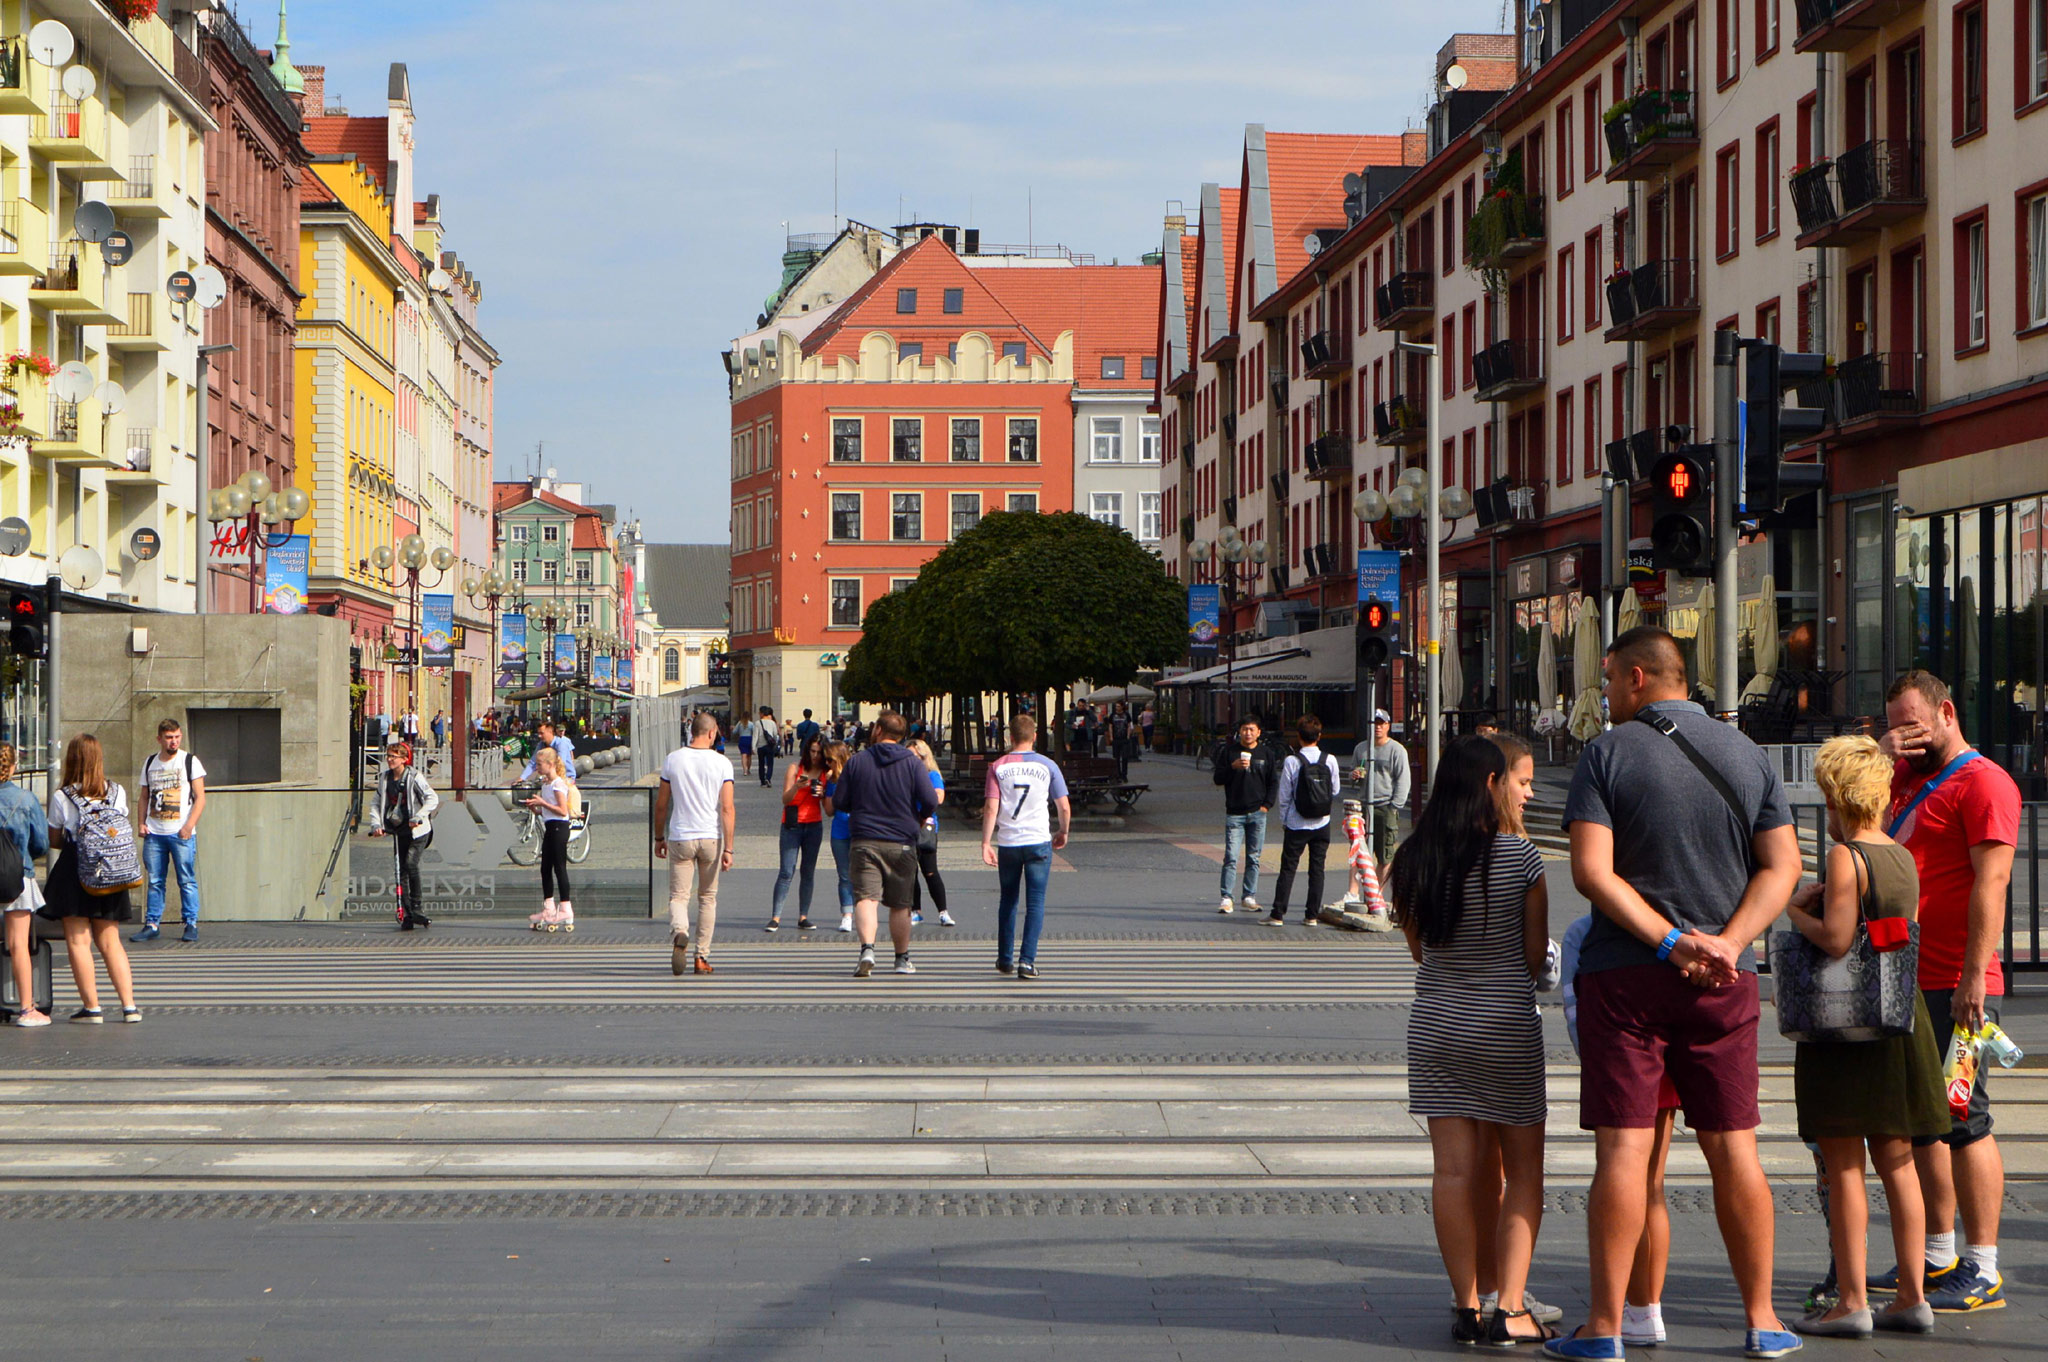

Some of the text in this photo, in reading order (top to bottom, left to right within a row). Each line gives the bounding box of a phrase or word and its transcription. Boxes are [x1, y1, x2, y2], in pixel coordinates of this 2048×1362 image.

[1628, 556, 1653, 568] eská
[998, 767, 1047, 782] GRIEZMANN
[1011, 783, 1030, 820] 7
